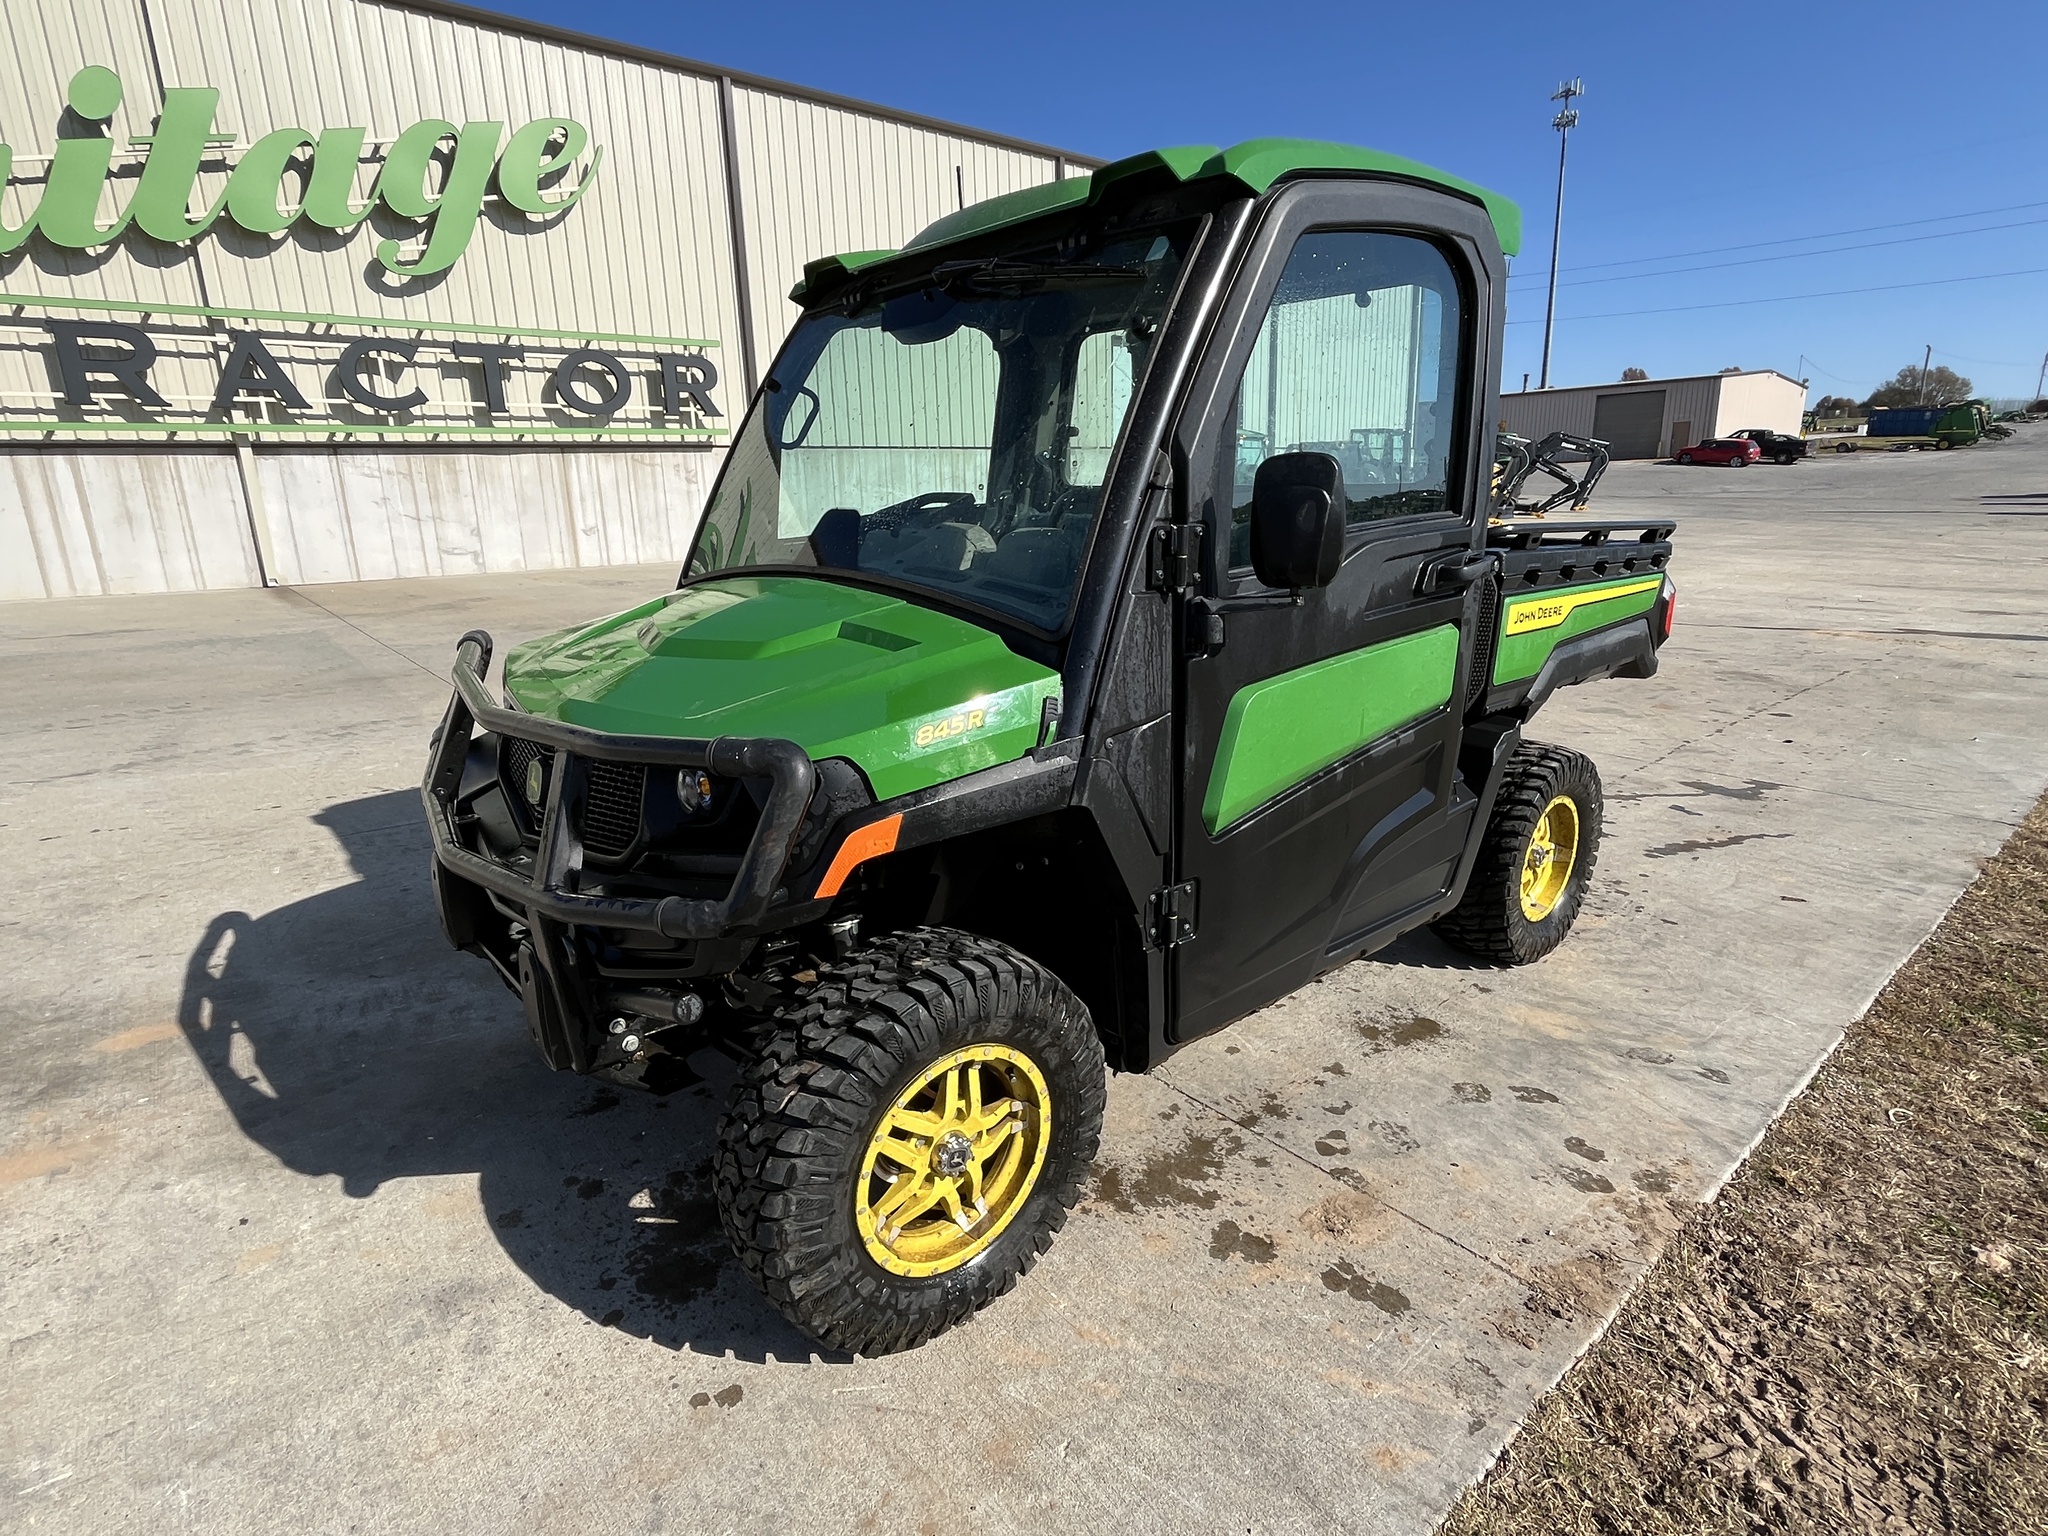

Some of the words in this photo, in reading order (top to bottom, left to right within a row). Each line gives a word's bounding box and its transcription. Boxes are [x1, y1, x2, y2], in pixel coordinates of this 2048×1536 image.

[0, 65, 604, 277] itage
[45, 319, 725, 418] RACTOR
[1514, 610, 1536, 624] JOHN
[1538, 605, 1563, 619] DEERE
